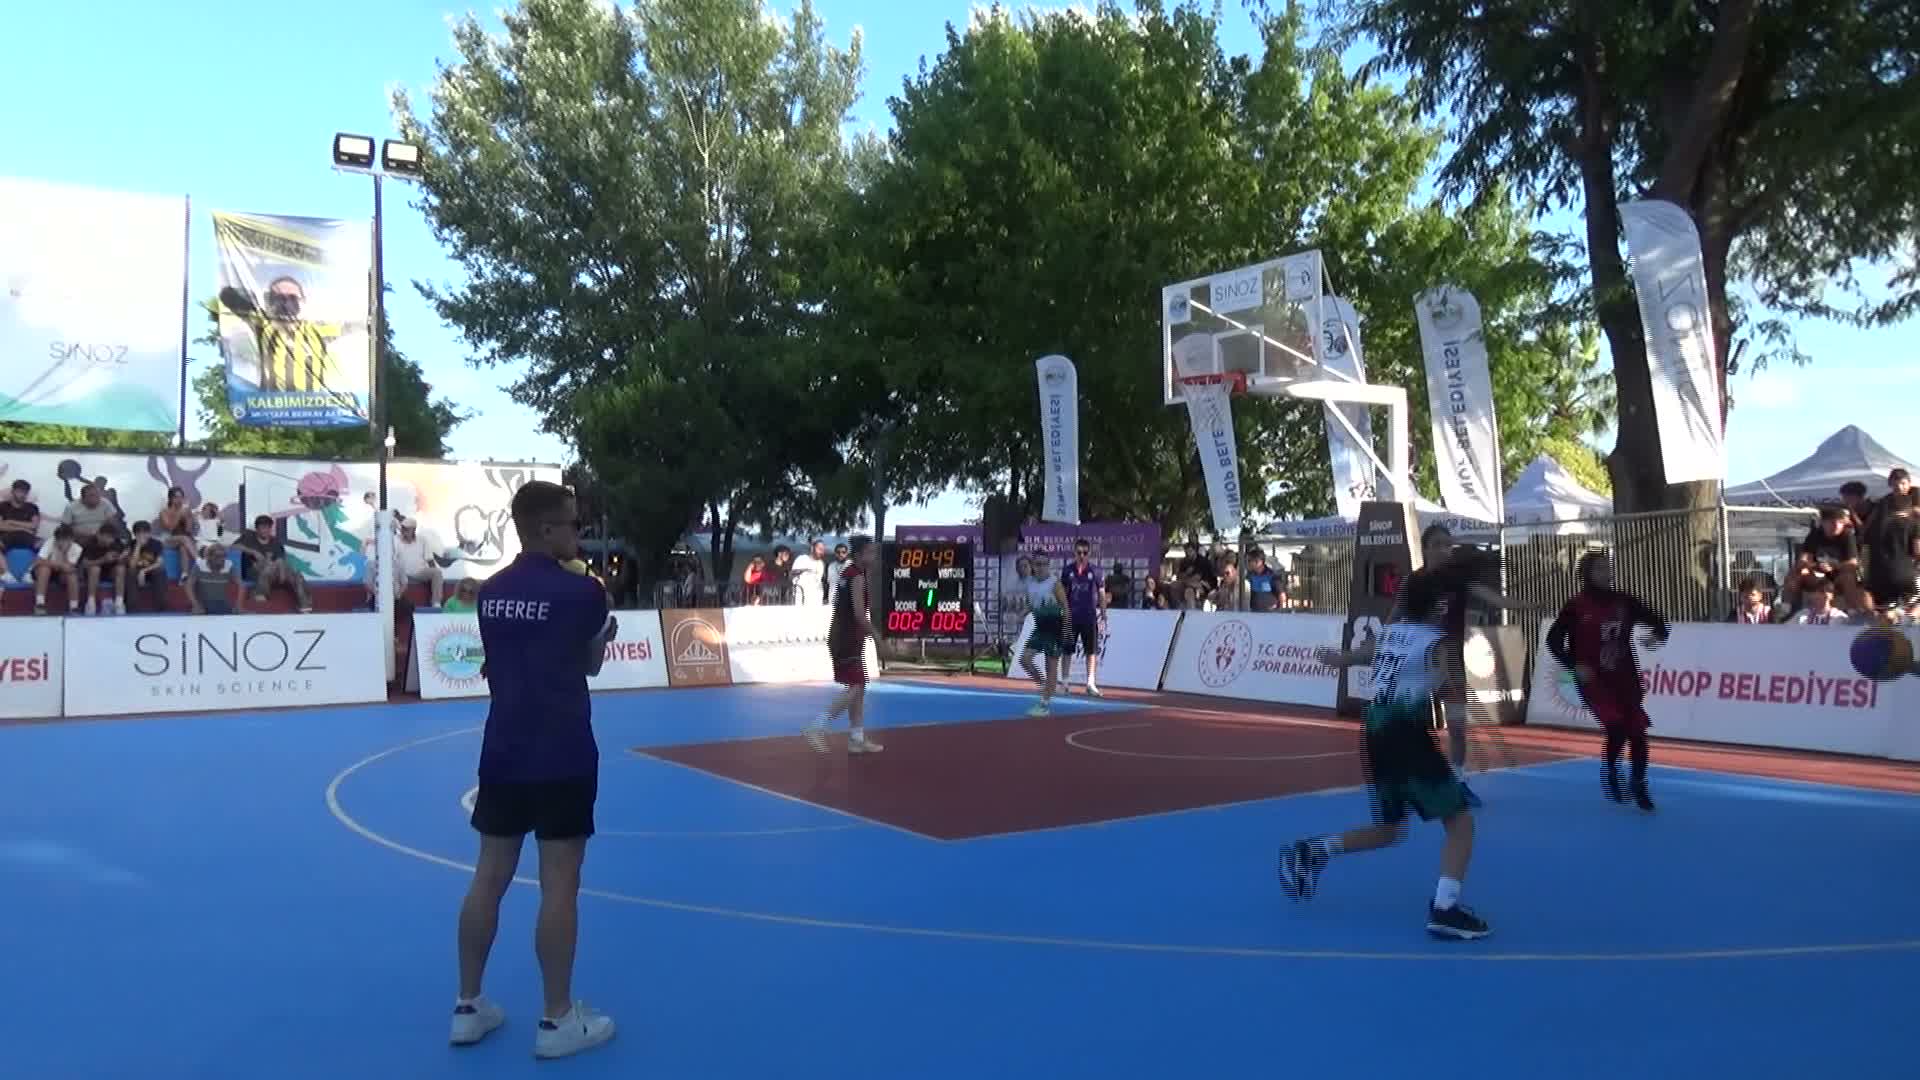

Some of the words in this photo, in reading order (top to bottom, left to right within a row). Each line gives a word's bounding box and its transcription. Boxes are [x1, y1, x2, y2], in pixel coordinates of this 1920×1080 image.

[901, 550, 955, 567] 08:49
[894, 567, 911, 578] HOME
[918, 579, 938, 589] Period
[481, 599, 551, 620] REFEREE
[895, 601, 917, 611] SCORE
[937, 601, 960, 611] SCORE
[888, 612, 924, 630] 002
[931, 612, 967, 630] 002
[133, 629, 327, 676] SİNOZ
[1252, 660, 1280, 673] SPOR
[151, 684, 201, 697] SKIN
[217, 680, 313, 695] SCIENCE
[1640, 664, 1712, 696] SİNOP
[1718, 671, 1878, 708] BELEDİYESİ
